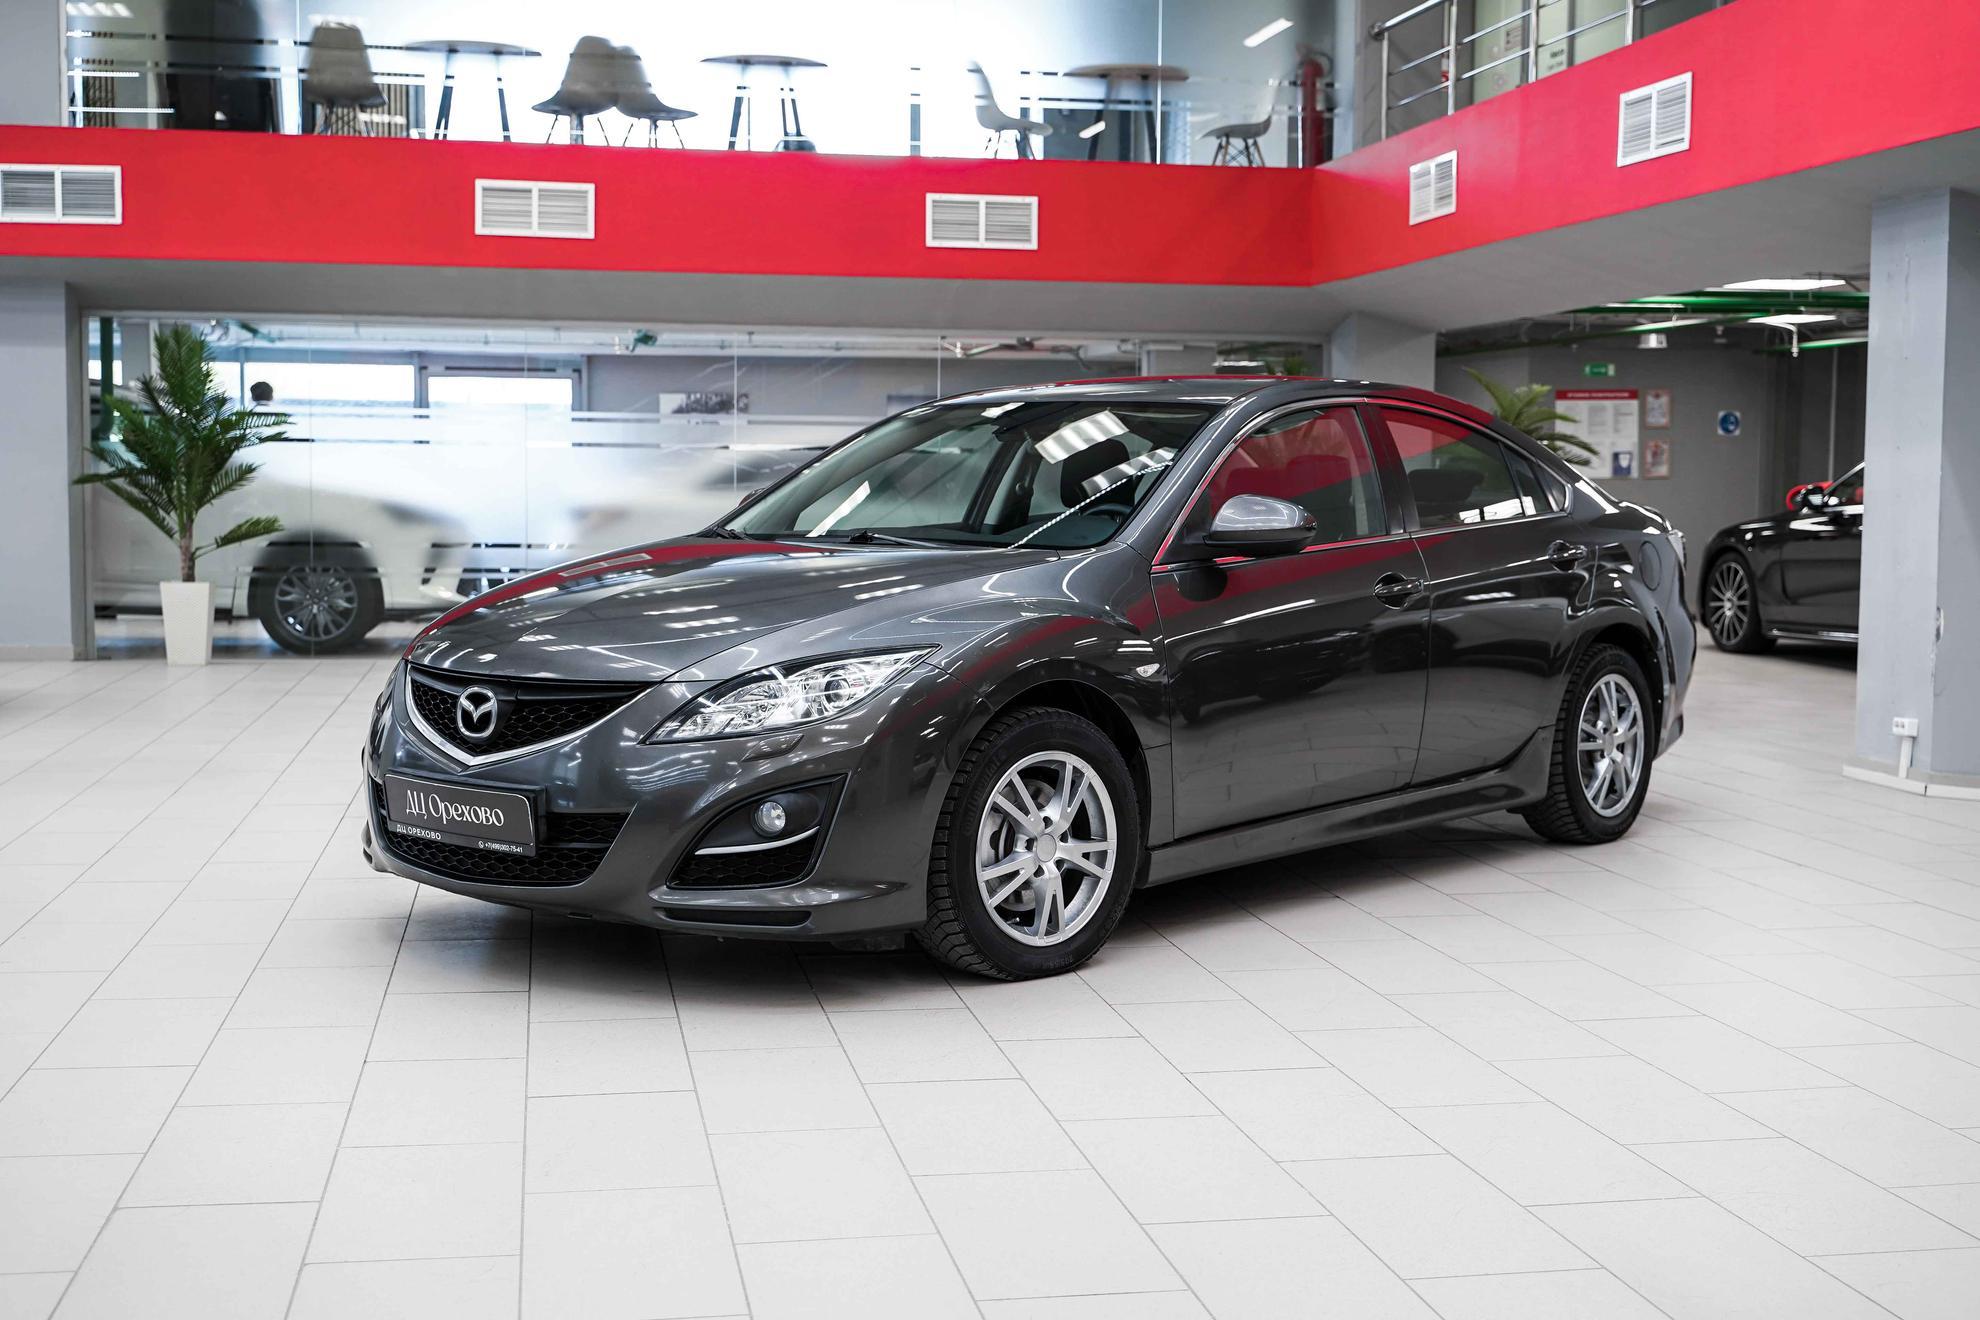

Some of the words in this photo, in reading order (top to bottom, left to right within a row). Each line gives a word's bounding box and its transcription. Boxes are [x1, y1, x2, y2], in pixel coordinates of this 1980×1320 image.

[406, 790, 428, 819] ДЦ
[428, 794, 504, 826] Орехово
[397, 824, 407, 834] ДЦ
[408, 827, 441, 840] ОРЕХОВО
